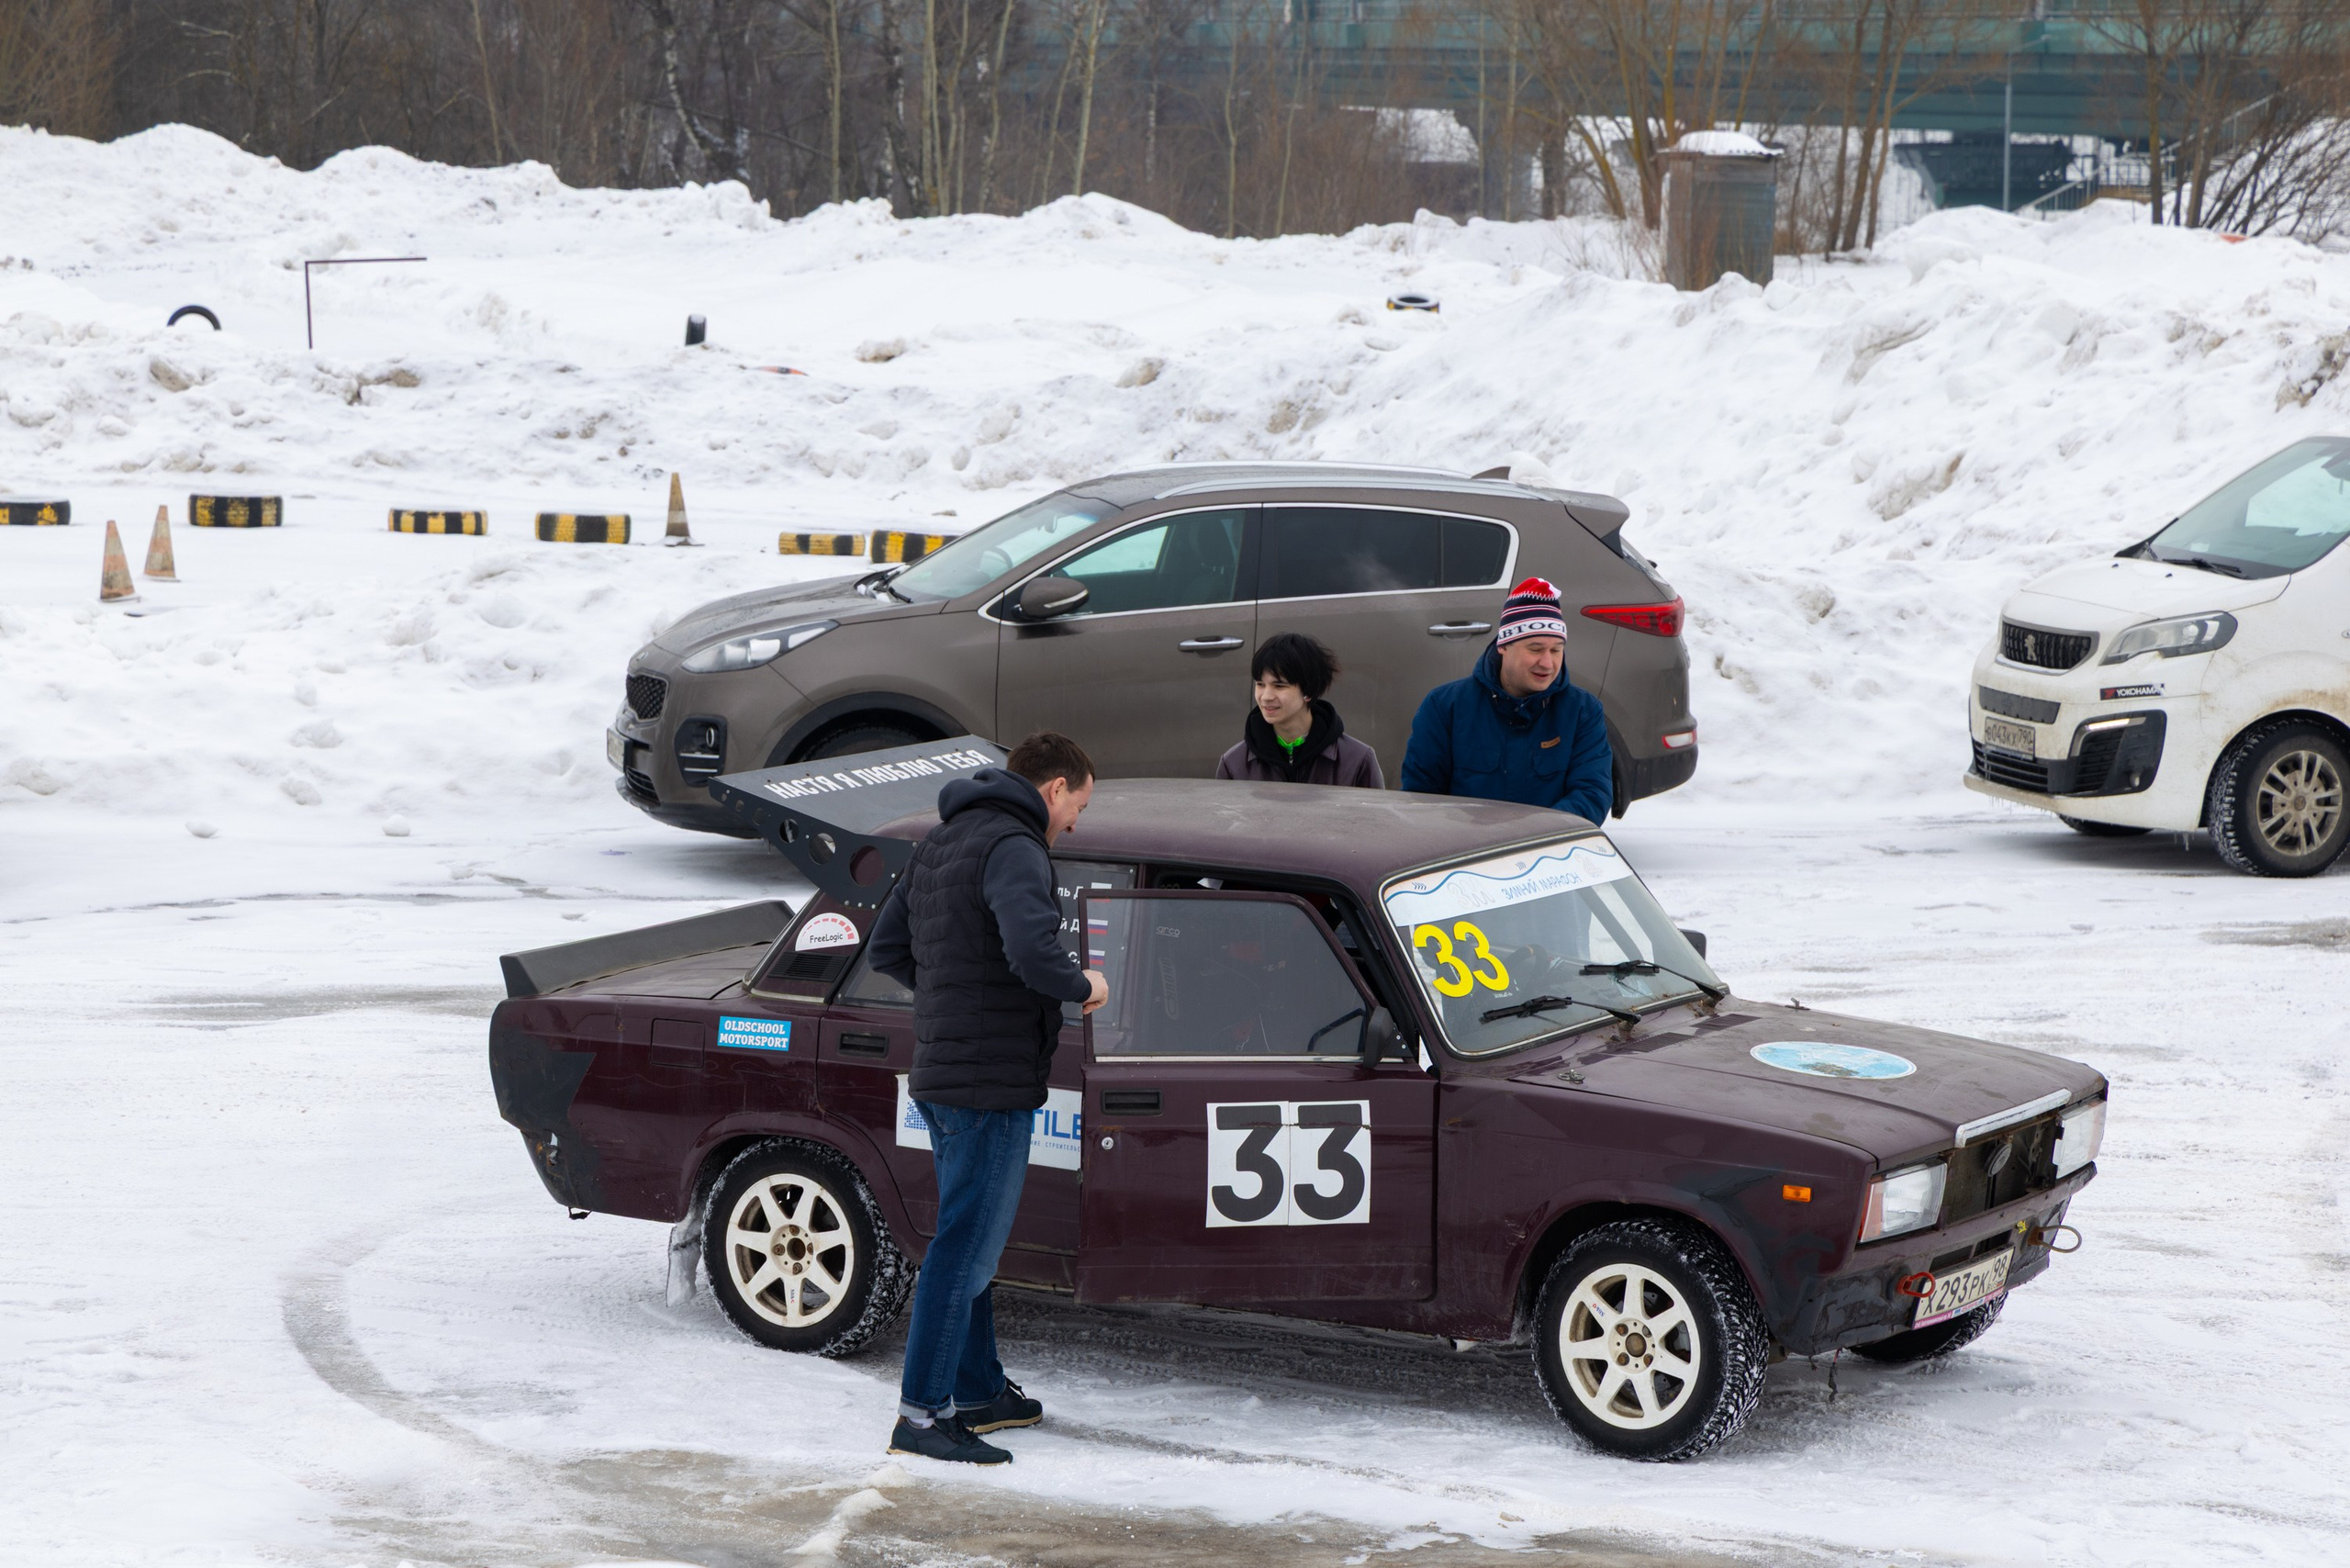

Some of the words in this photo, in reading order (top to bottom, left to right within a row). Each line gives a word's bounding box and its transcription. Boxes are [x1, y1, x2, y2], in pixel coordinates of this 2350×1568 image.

[764, 775, 837, 800] НАСТЯ
[834, 772, 863, 789] Я
[850, 758, 944, 786] ЛЮБЛЮ
[930, 749, 995, 770] ТЕБЯ
[1501, 879, 1541, 900] ЗИМНИЙ
[1539, 872, 1583, 890] МАРАФОН
[809, 932, 844, 944] FreeLogic
[1414, 921, 1510, 998] 33
[719, 1033, 789, 1048] MOTORSPORT
[724, 1020, 786, 1035] OLDSCHOOL
[1211, 1103, 1366, 1222] 33
[1993, 1255, 2008, 1282] 98
